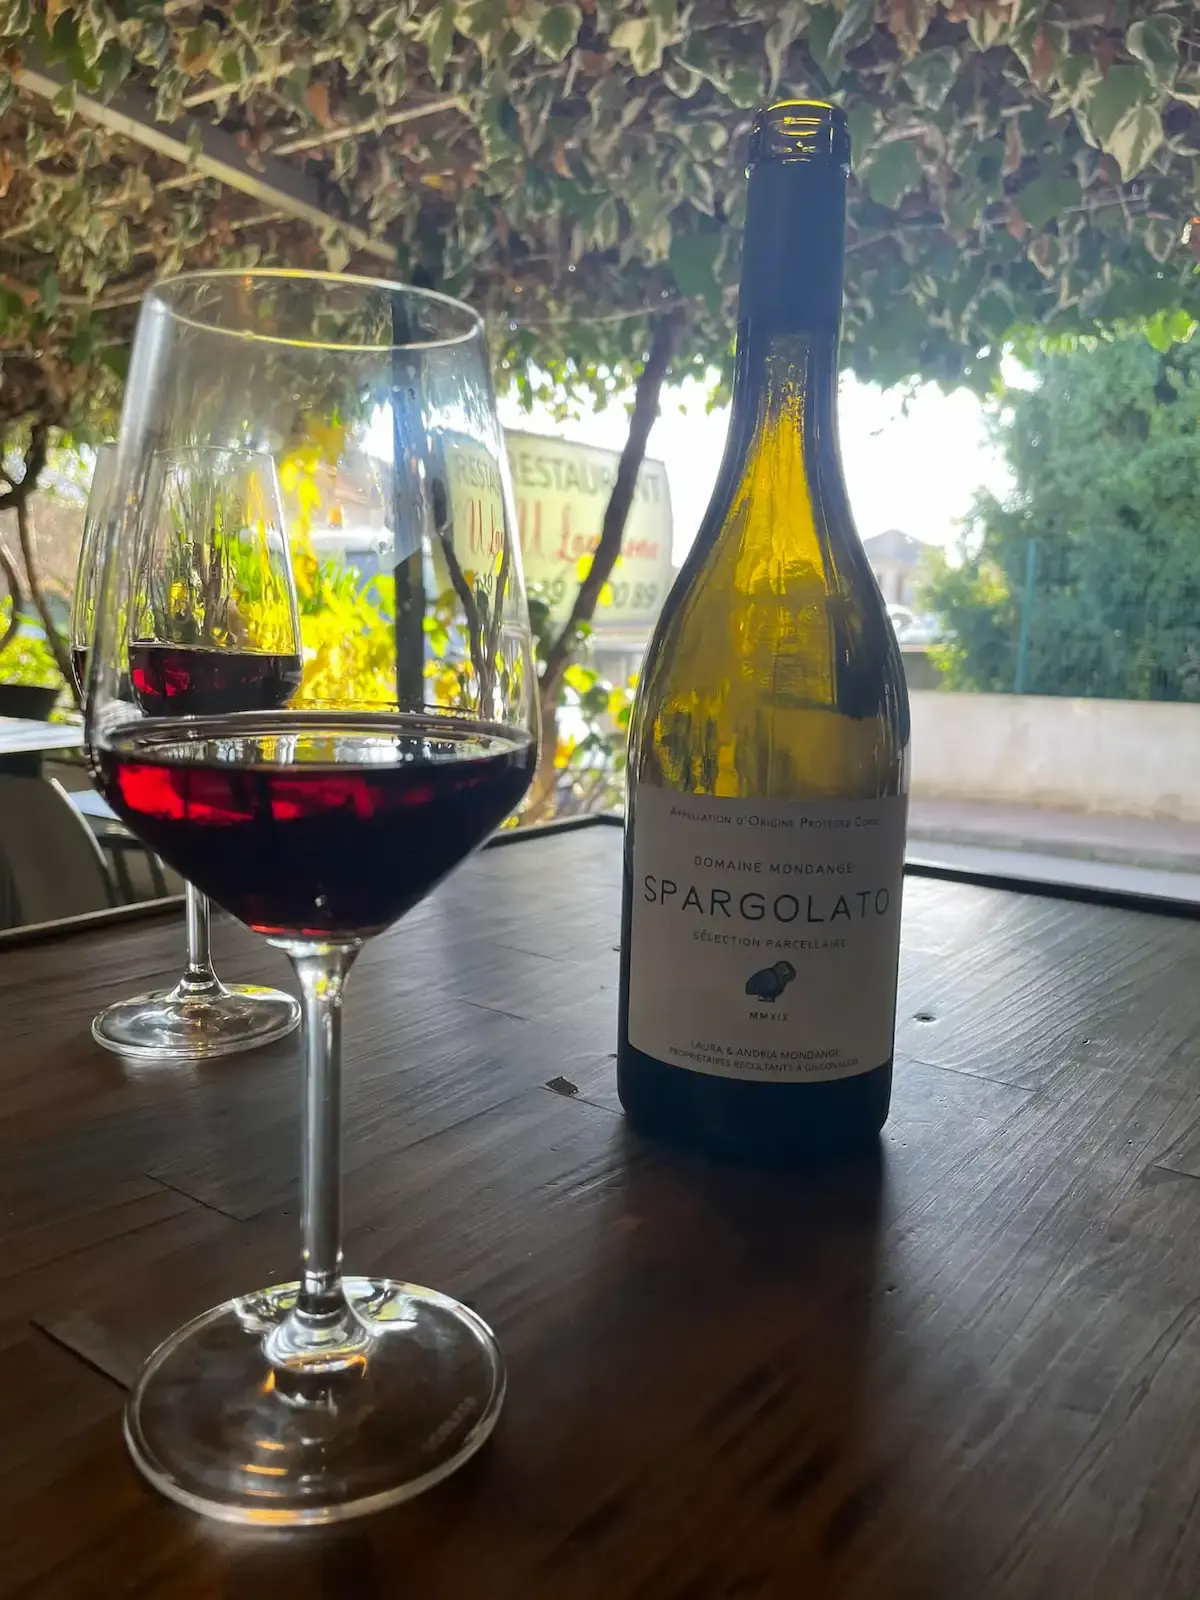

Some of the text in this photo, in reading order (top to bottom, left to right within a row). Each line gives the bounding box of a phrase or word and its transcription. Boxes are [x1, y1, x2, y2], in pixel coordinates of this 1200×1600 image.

[669, 806, 732, 824] APPELLATION
[694, 855, 854, 875] DOMAINE MONDANGE
[643, 874, 890, 924] SPARGOLATO
[693, 929, 848, 950] SÉLECTION PARCELLAIRE
[749, 1011, 789, 1022] MMXIX
[691, 1040, 842, 1060] LAURA & ANDRIA MONDANGE
